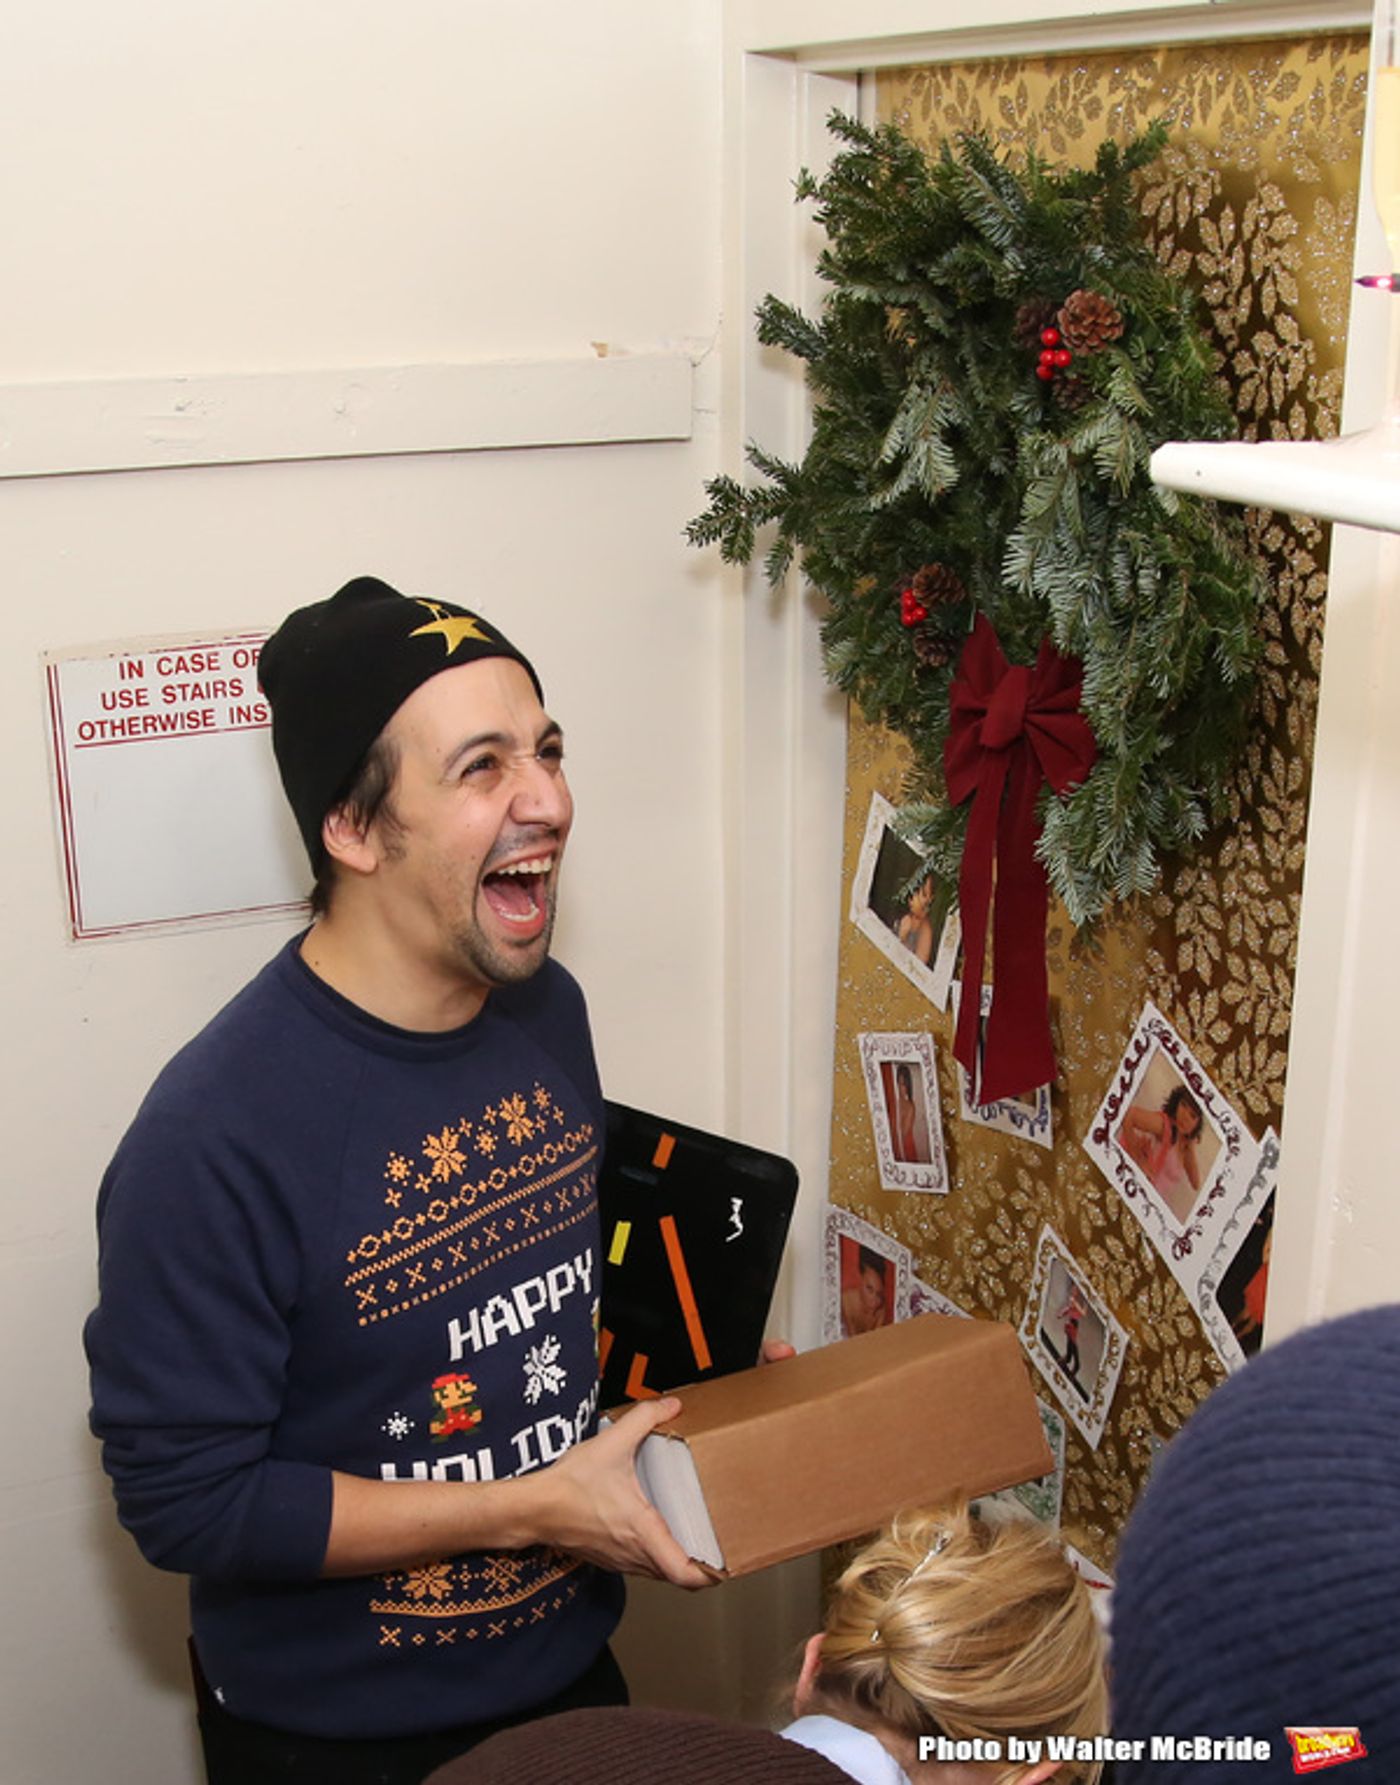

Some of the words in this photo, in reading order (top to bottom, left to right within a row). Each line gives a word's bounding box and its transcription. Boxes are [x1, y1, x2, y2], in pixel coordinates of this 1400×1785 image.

[118, 660, 144, 680] IN
[156, 652, 221, 676] CASE
[100, 688, 150, 711] USE
[161, 678, 245, 704] STAIRS
[78, 708, 216, 741] OTHERWISE
[229, 702, 273, 724] INS
[448, 1248, 593, 1362] HAPPY
